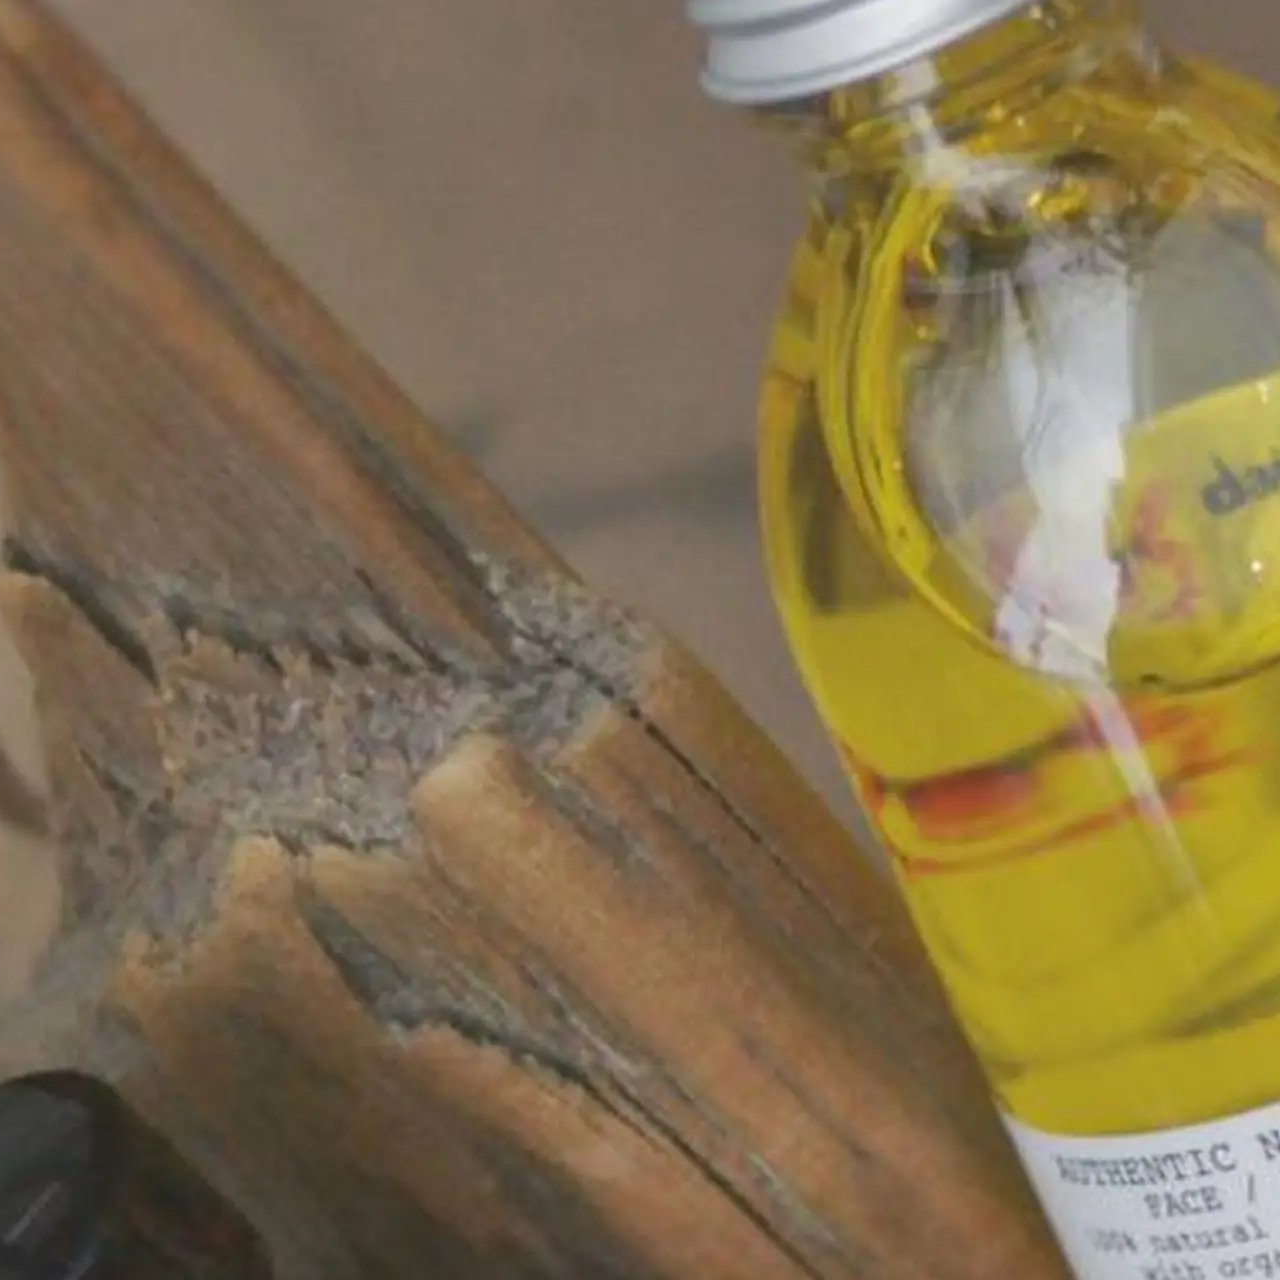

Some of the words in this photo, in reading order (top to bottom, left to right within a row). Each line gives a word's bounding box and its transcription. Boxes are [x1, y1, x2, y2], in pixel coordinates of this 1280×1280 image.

[1055, 1142, 1238, 1189] AUTHENTIC
[1146, 1187, 1223, 1221] FACE
[1245, 1174, 1257, 1202] /
[1149, 1212, 1268, 1261] natural
